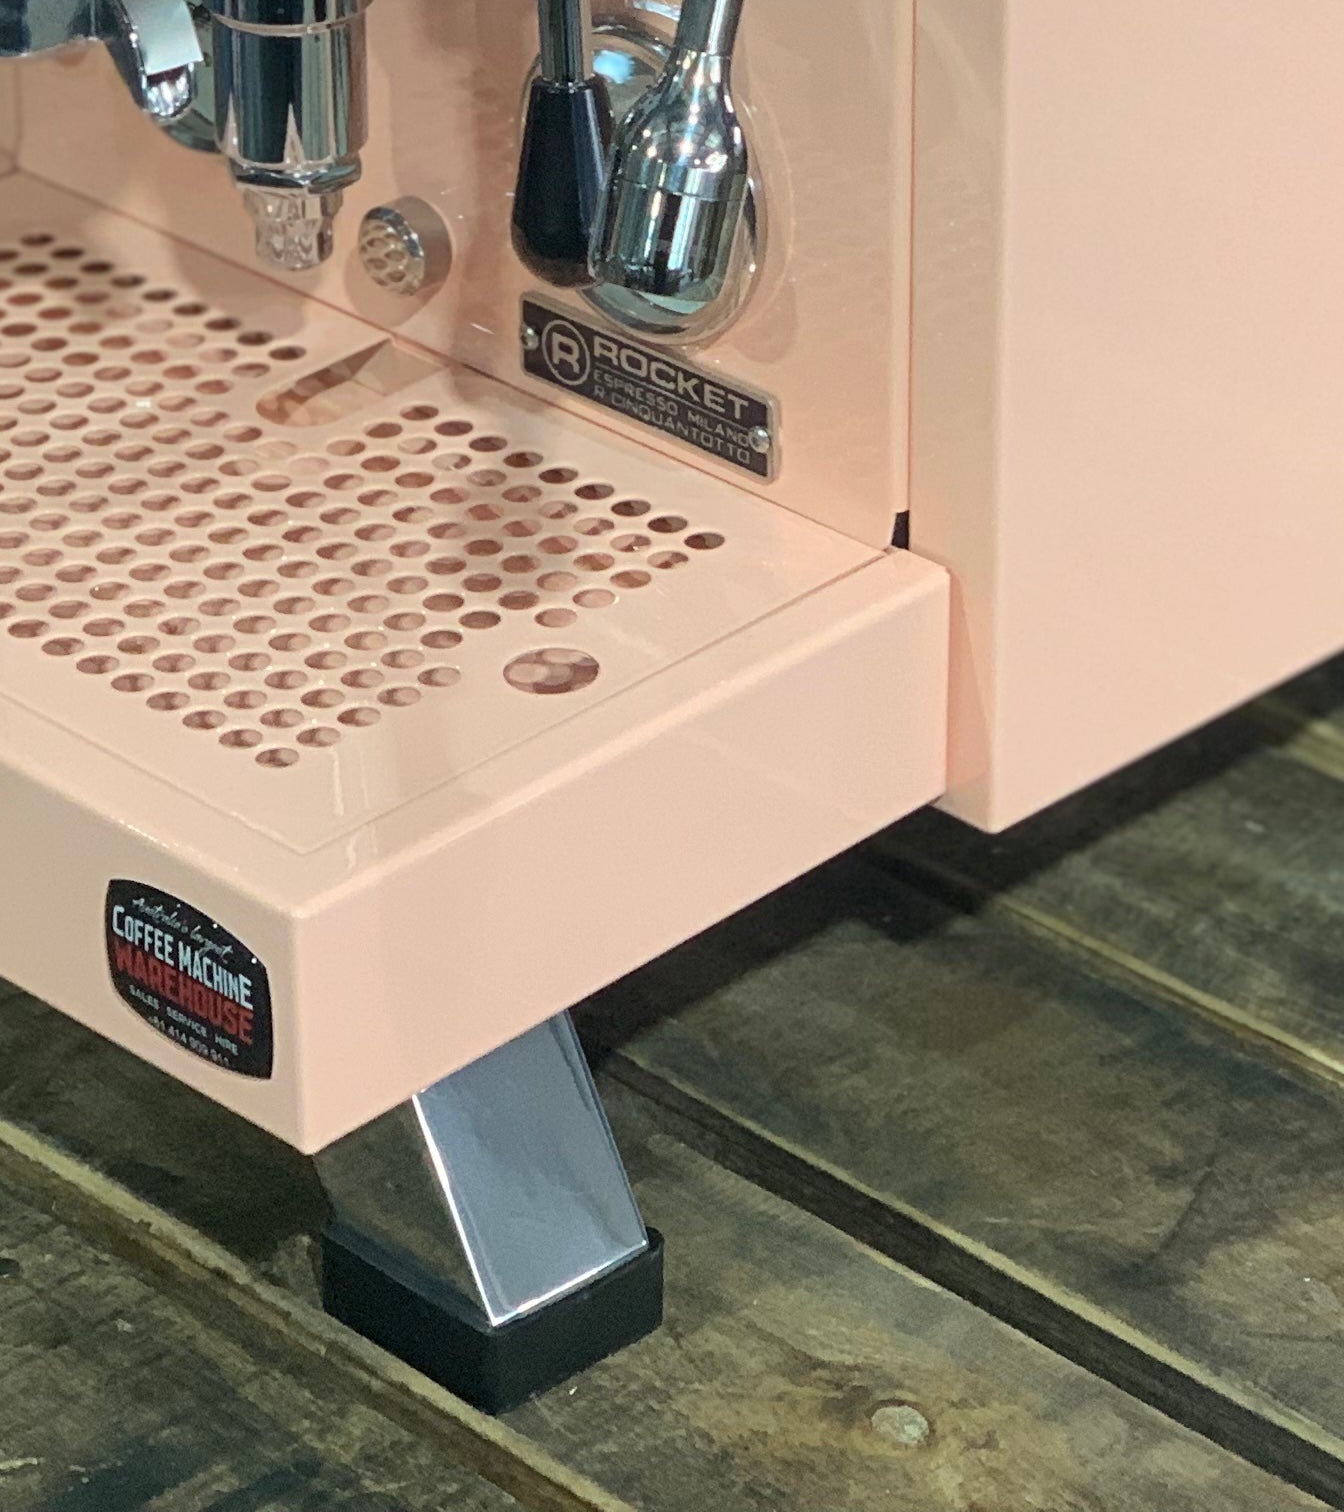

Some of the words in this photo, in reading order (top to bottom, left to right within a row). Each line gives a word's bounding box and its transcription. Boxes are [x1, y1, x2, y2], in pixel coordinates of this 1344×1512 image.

[593, 335, 750, 420] ROCKET
[593, 370, 679, 416] ESPRESSO
[687, 409, 750, 449] MILANO
[593, 385, 608, 401] R
[610, 391, 751, 465] CINQUANTOTTO
[112, 904, 175, 967] COFFEE
[178, 939, 254, 1010] MACHINE
[114, 940, 256, 1045] WAREHOUSE
[128, 984, 160, 1010] SALES
[166, 1006, 208, 1038] SERVICE
